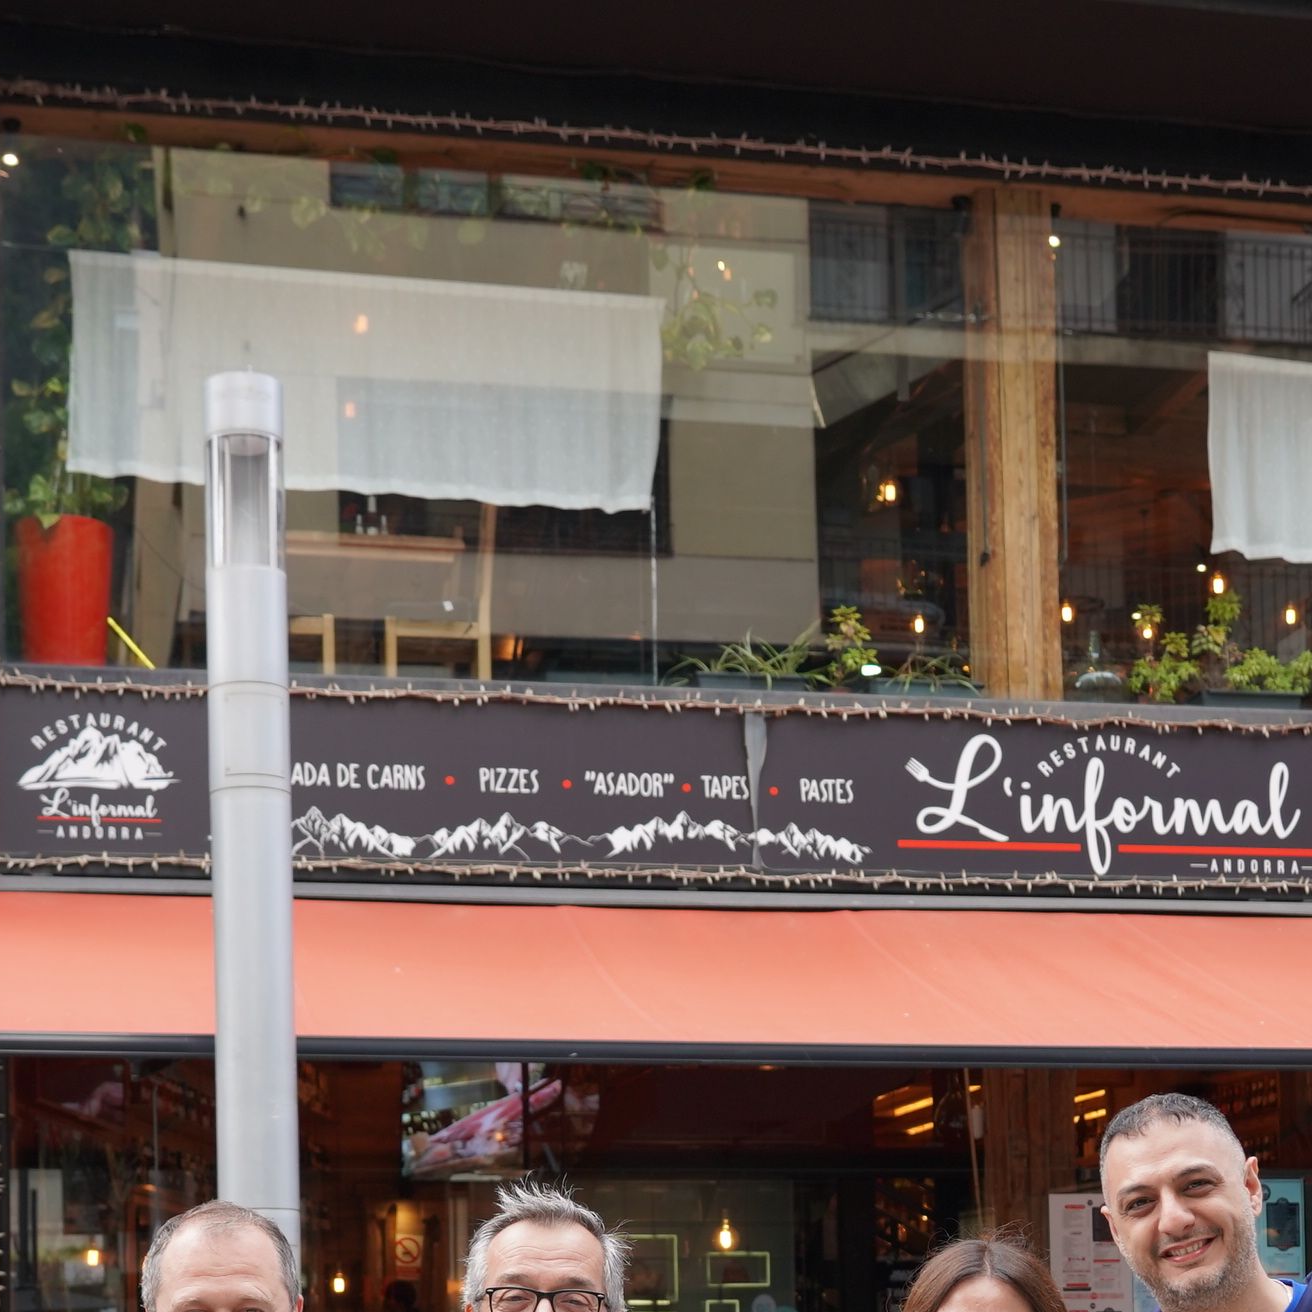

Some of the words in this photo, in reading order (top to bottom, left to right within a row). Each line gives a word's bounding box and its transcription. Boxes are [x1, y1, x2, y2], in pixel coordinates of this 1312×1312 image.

[30, 712, 167, 753] RESTAURANT
[1037, 735, 1182, 779] RESTAURANT
[336, 763, 361, 788] DE
[367, 764, 426, 791] CARNS
[478, 767, 539, 794] PIZZES
[701, 775, 750, 800] TAPES
[800, 778, 854, 804] PASTES
[38, 787, 158, 827] L'informal
[904, 733, 1301, 876] L'informal
[56, 826, 144, 841] ANDORRA
[1209, 859, 1299, 875] ANDORRA
